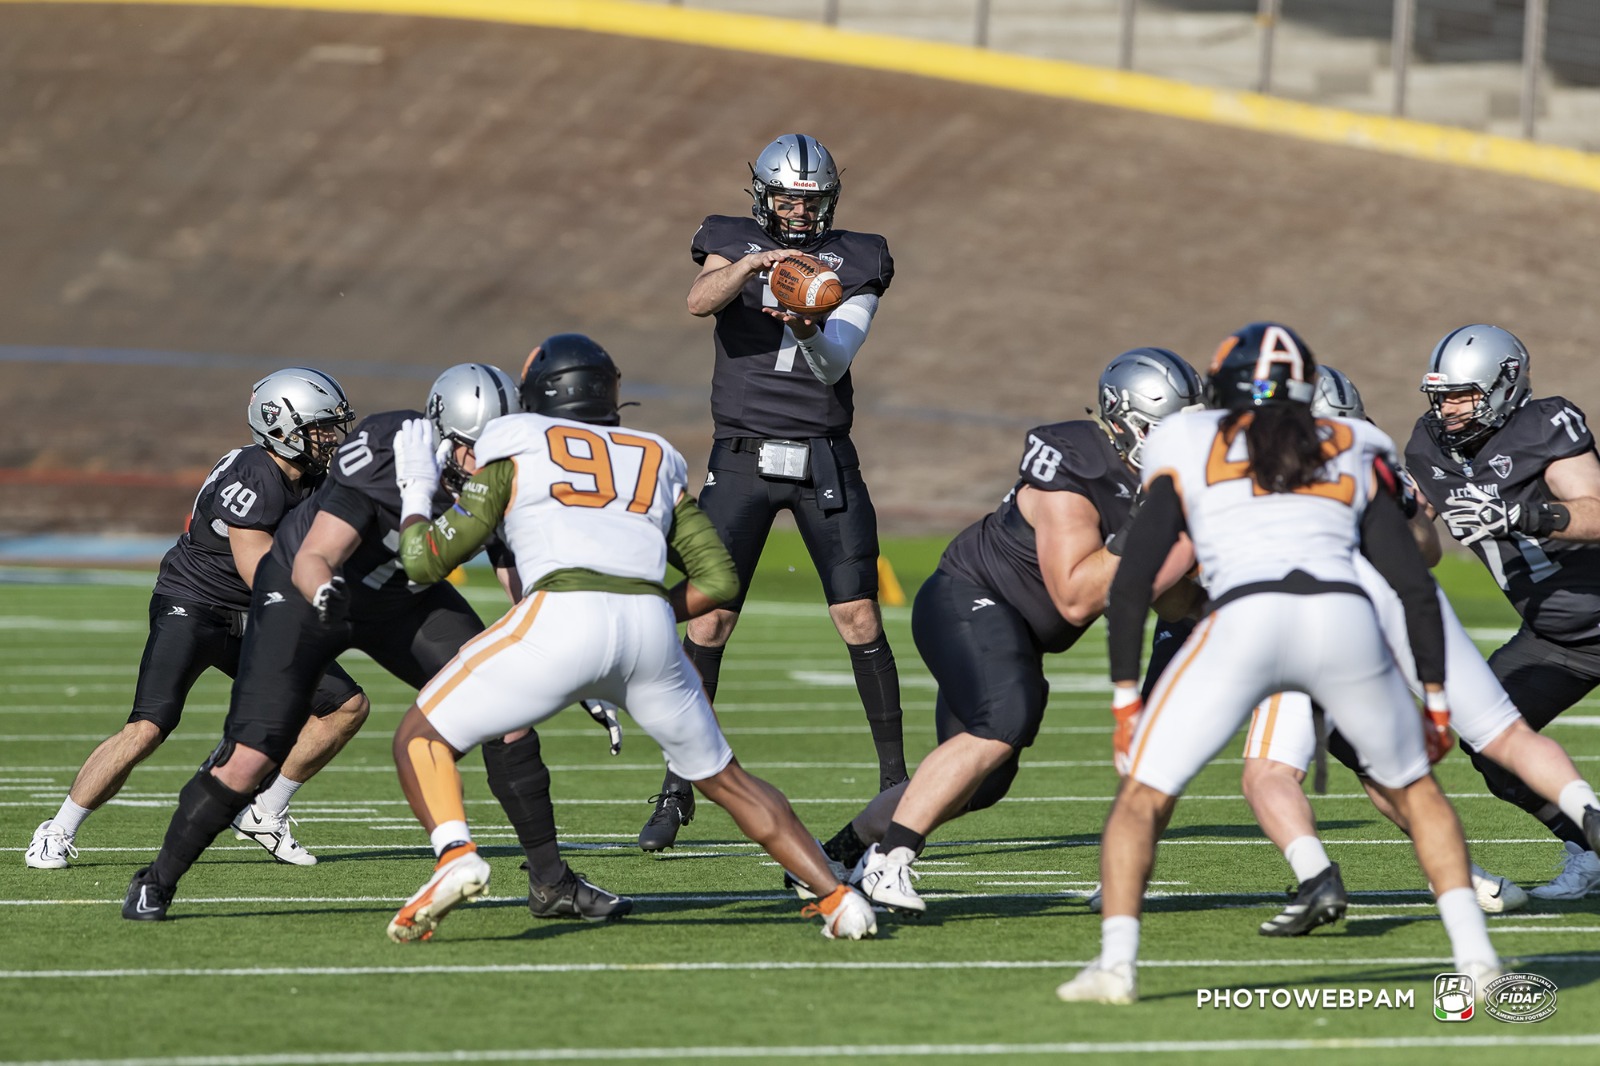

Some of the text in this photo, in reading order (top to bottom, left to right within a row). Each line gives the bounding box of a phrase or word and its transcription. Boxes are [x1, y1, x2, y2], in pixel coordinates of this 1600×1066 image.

[777, 281, 796, 293] PRIME
[779, 268, 799, 283] Wilson
[1254, 326, 1304, 381] A
[1550, 406, 1587, 443] 71
[338, 431, 374, 477] 70
[545, 424, 664, 515] 97
[1020, 434, 1063, 483] 78
[220, 480, 258, 518] 49
